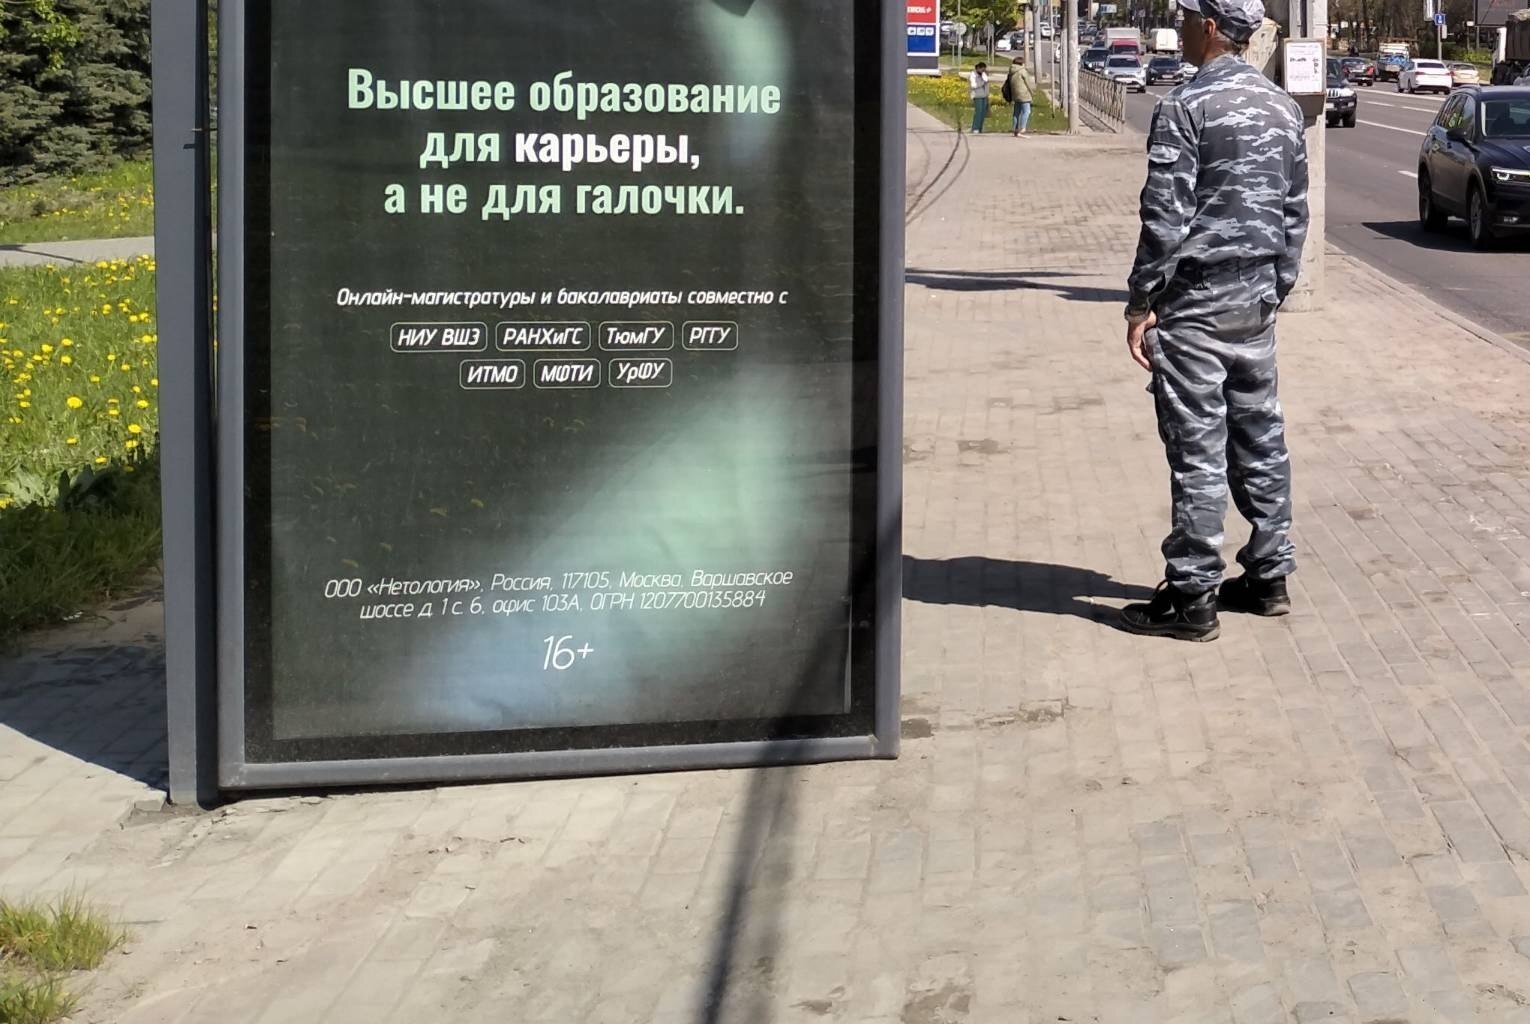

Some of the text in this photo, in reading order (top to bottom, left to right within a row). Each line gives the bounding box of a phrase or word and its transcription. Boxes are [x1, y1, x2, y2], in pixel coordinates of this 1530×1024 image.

[348, 68, 782, 120] Высшее образование
[419, 132, 700, 172] для карьеры,
[384, 184, 745, 220] а не для галочки.
[337, 288, 789, 309] Онлайн-магистратуры и бакалавриаты совместно с
[398, 328, 438, 346] НИУ
[503, 327, 583, 345] РАНХиГС
[607, 327, 665, 344] ТюмГУ
[689, 327, 731, 344] РГГУ
[467, 365, 518, 383] ИТМО
[541, 364, 594, 382] МФТИ
[616, 362, 665, 383] УрФУ
[324, 579, 362, 599] ООО
[491, 573, 553, 592] Россия,
[562, 571, 612, 590] 117105,
[691, 569, 794, 590] Варшавское
[360, 602, 414, 619] шоссе
[442, 597, 448, 615] 1
[492, 597, 536, 616] офис
[590, 592, 634, 610] ОГРН
[640, 590, 766, 609] 1207700135884
[543, 634, 595, 670] 16+
